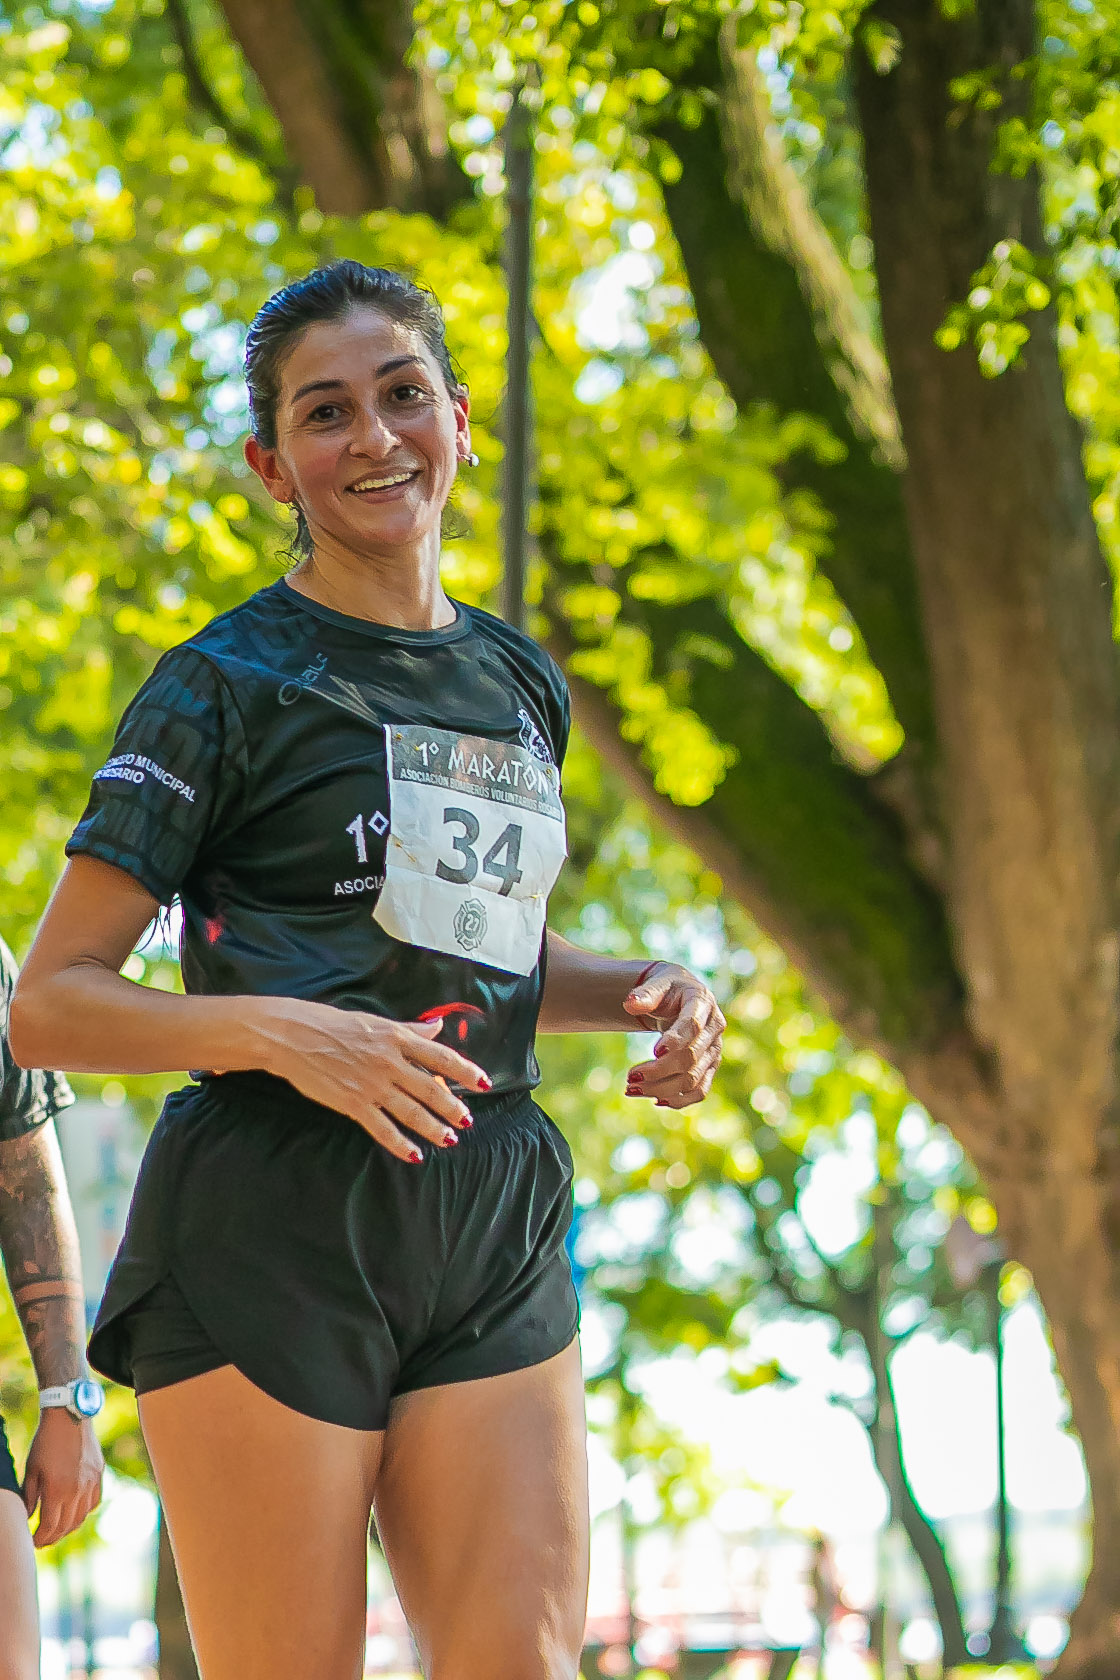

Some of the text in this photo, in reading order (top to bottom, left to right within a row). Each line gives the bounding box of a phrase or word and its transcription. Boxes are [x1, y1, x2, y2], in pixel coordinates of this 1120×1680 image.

[134, 754, 196, 802] MUNICIPAL
[447, 745, 549, 795] MARATÓN
[346, 810, 390, 864] 1°
[435, 807, 524, 897] 34
